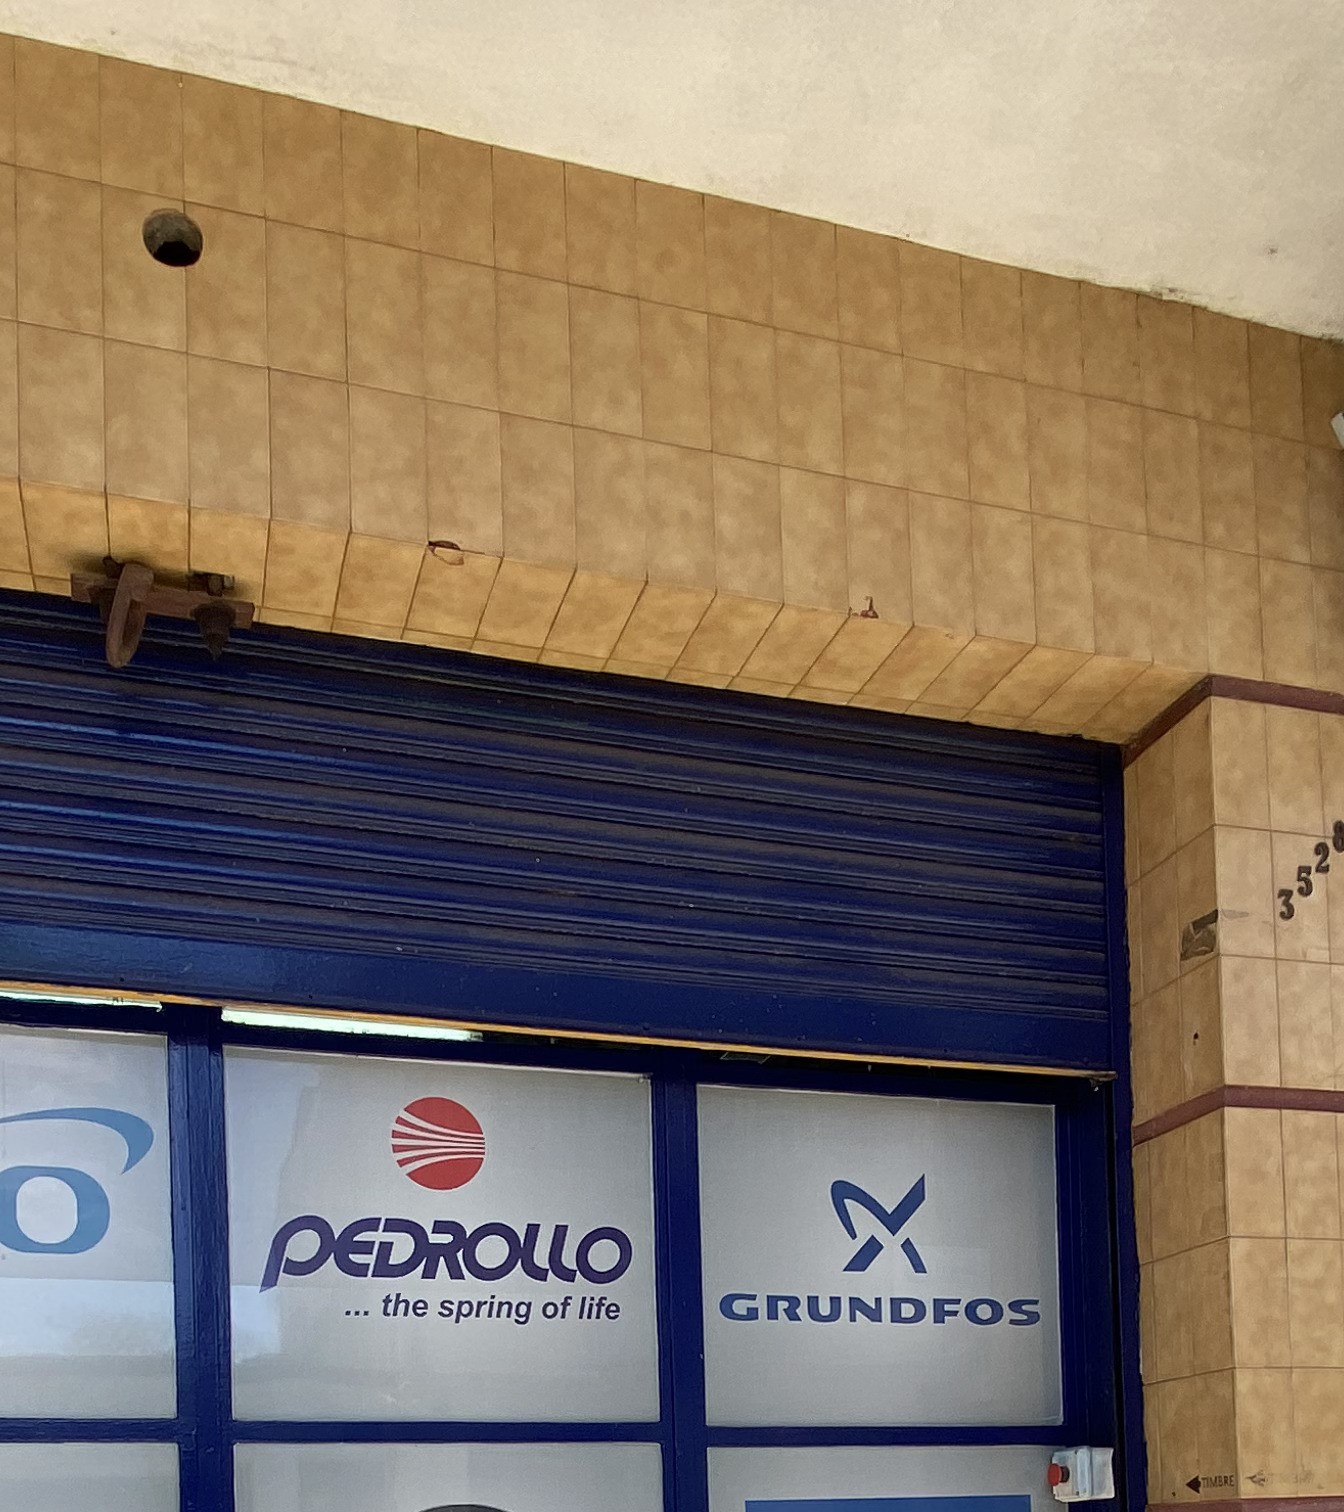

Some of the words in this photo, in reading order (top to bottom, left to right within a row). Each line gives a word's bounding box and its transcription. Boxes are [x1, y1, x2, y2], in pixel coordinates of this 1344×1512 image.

[258, 1214, 633, 1293] PEDROLLO
[382, 1294, 429, 1318] the
[438, 1294, 532, 1326] spring
[541, 1296, 574, 1320] of
[578, 1296, 622, 1321] life
[719, 1292, 1041, 1327] GRUNDFOS
[1200, 1474, 1235, 1489] TIMBRE
